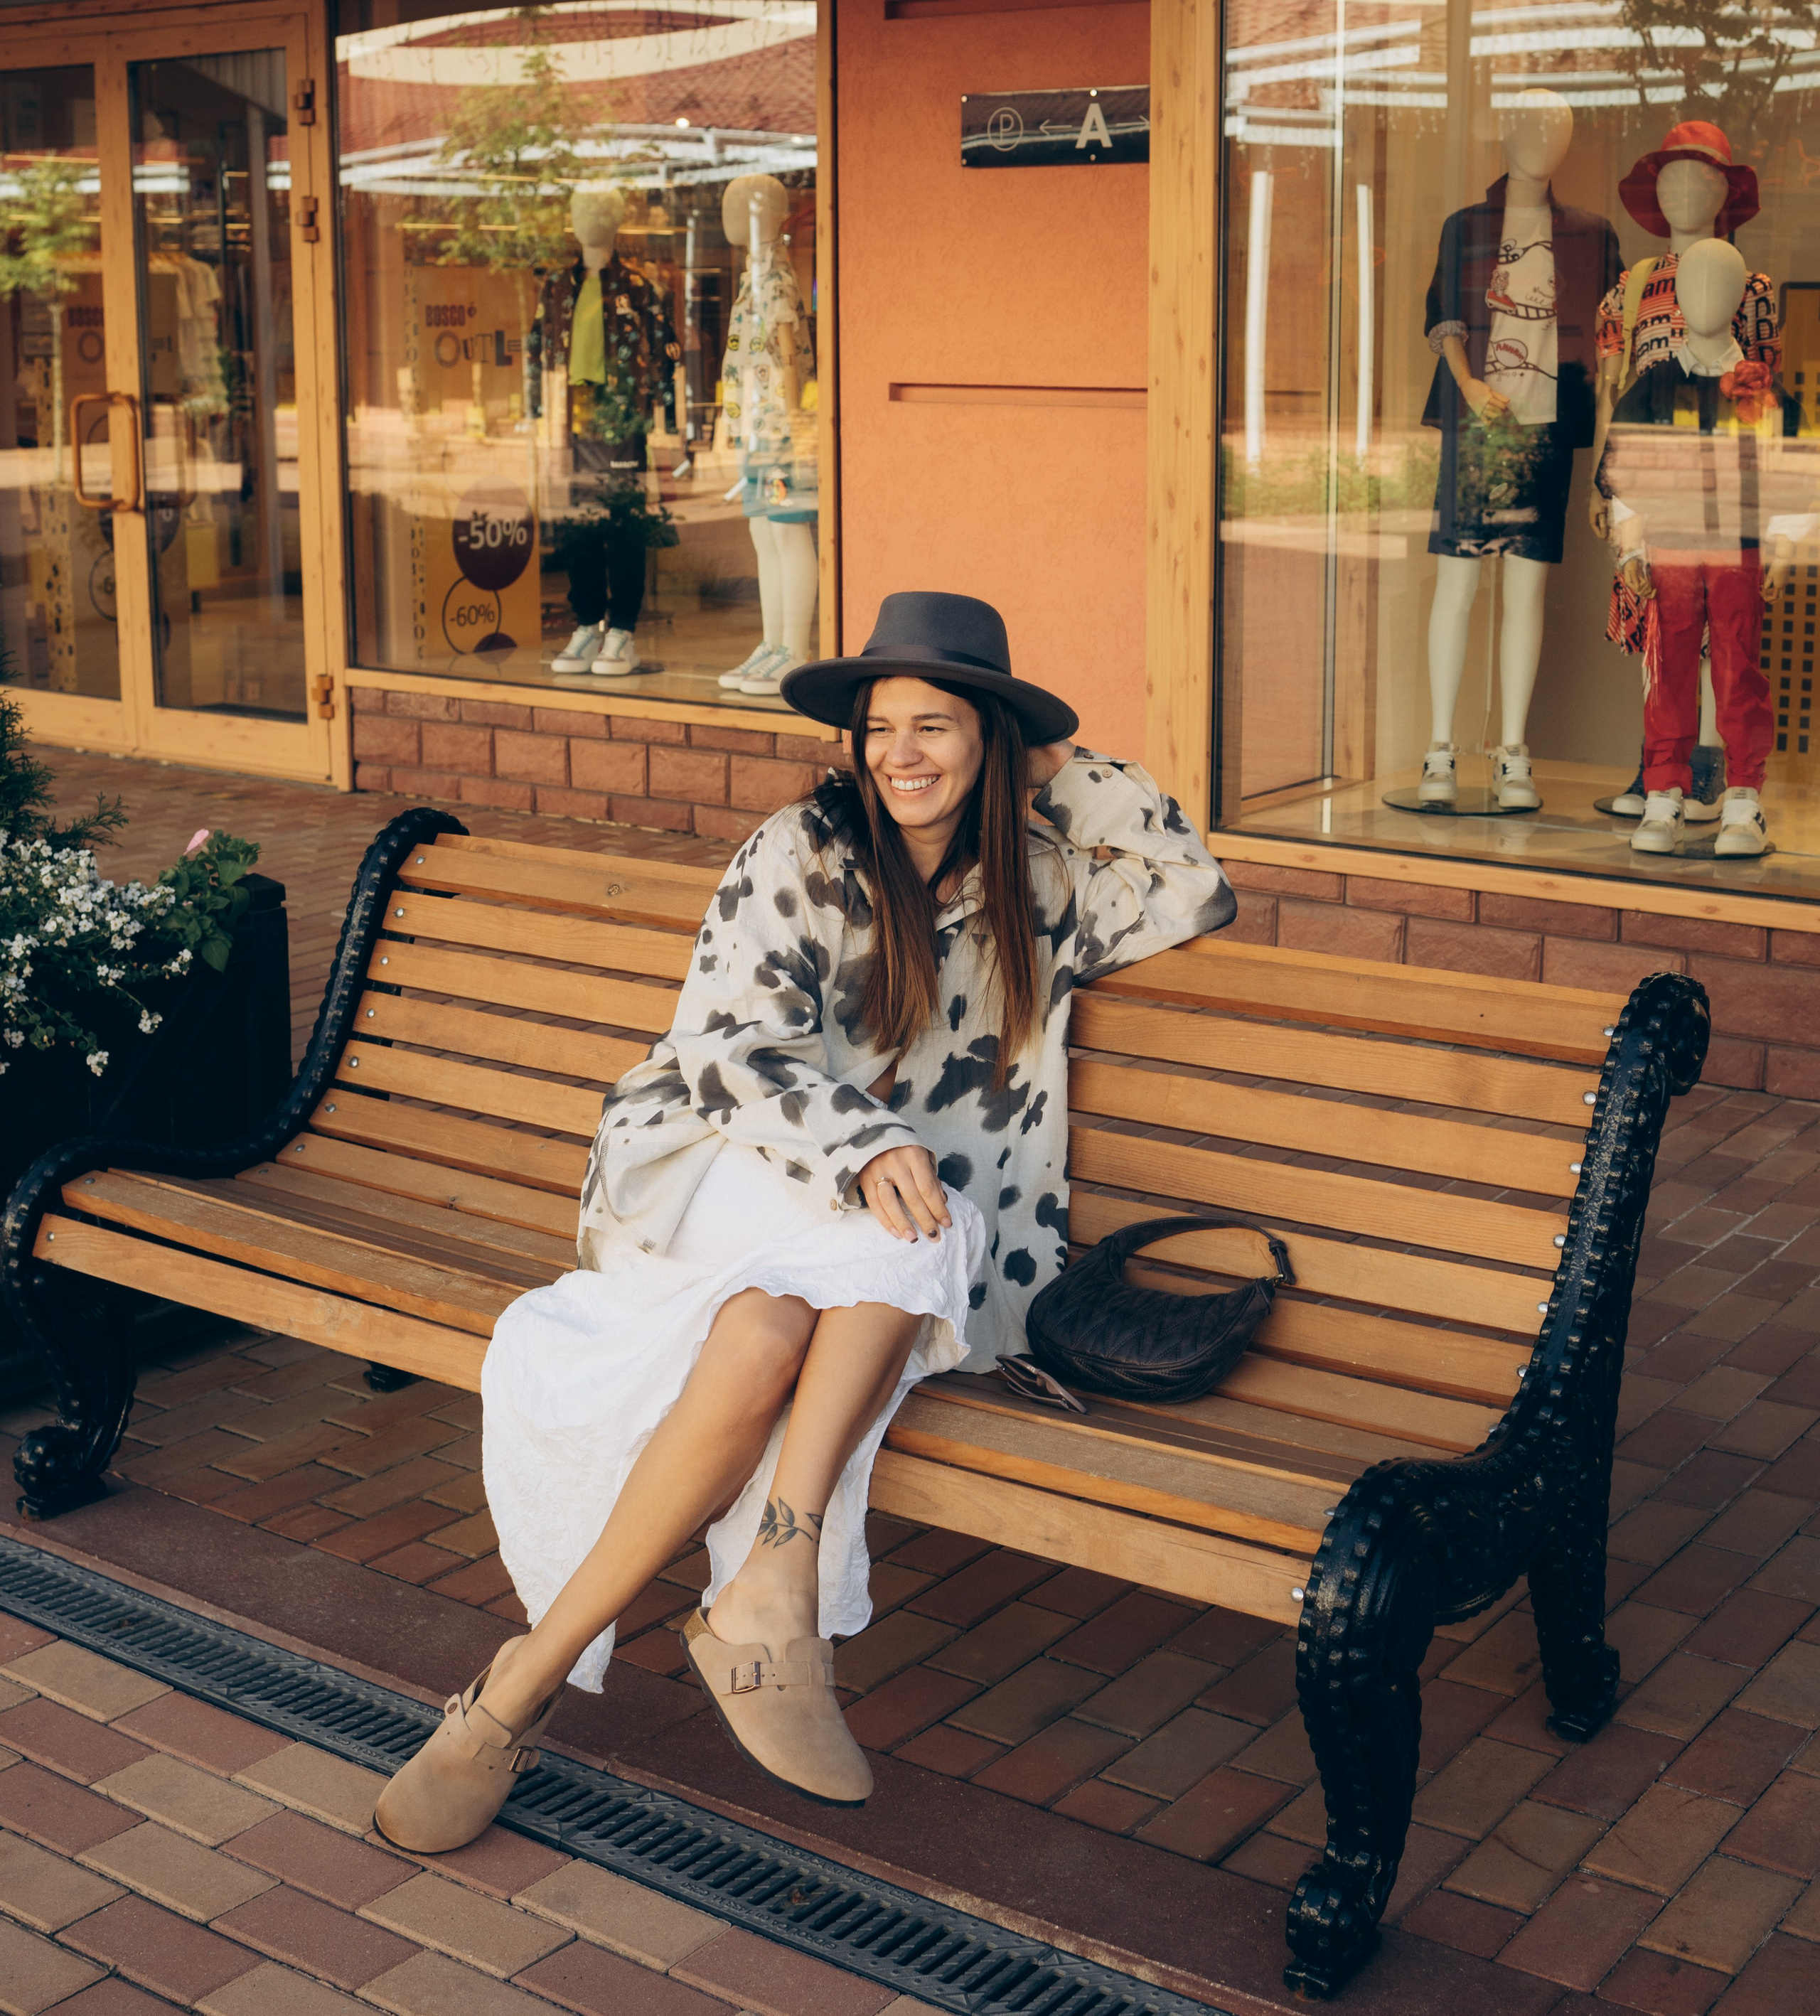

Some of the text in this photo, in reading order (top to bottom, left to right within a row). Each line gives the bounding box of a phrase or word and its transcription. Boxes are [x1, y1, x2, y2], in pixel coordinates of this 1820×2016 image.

[1075, 102, 1113, 149] A
[434, 329, 522, 368] OUTLE
[458, 518, 528, 549] -50%
[449, 603, 496, 627] -60%
[411, 1703, 446, 1720] GIDROL
[764, 1839, 825, 1868] GIDROLICA
[771, 1920, 837, 1950] GIDROLICA
